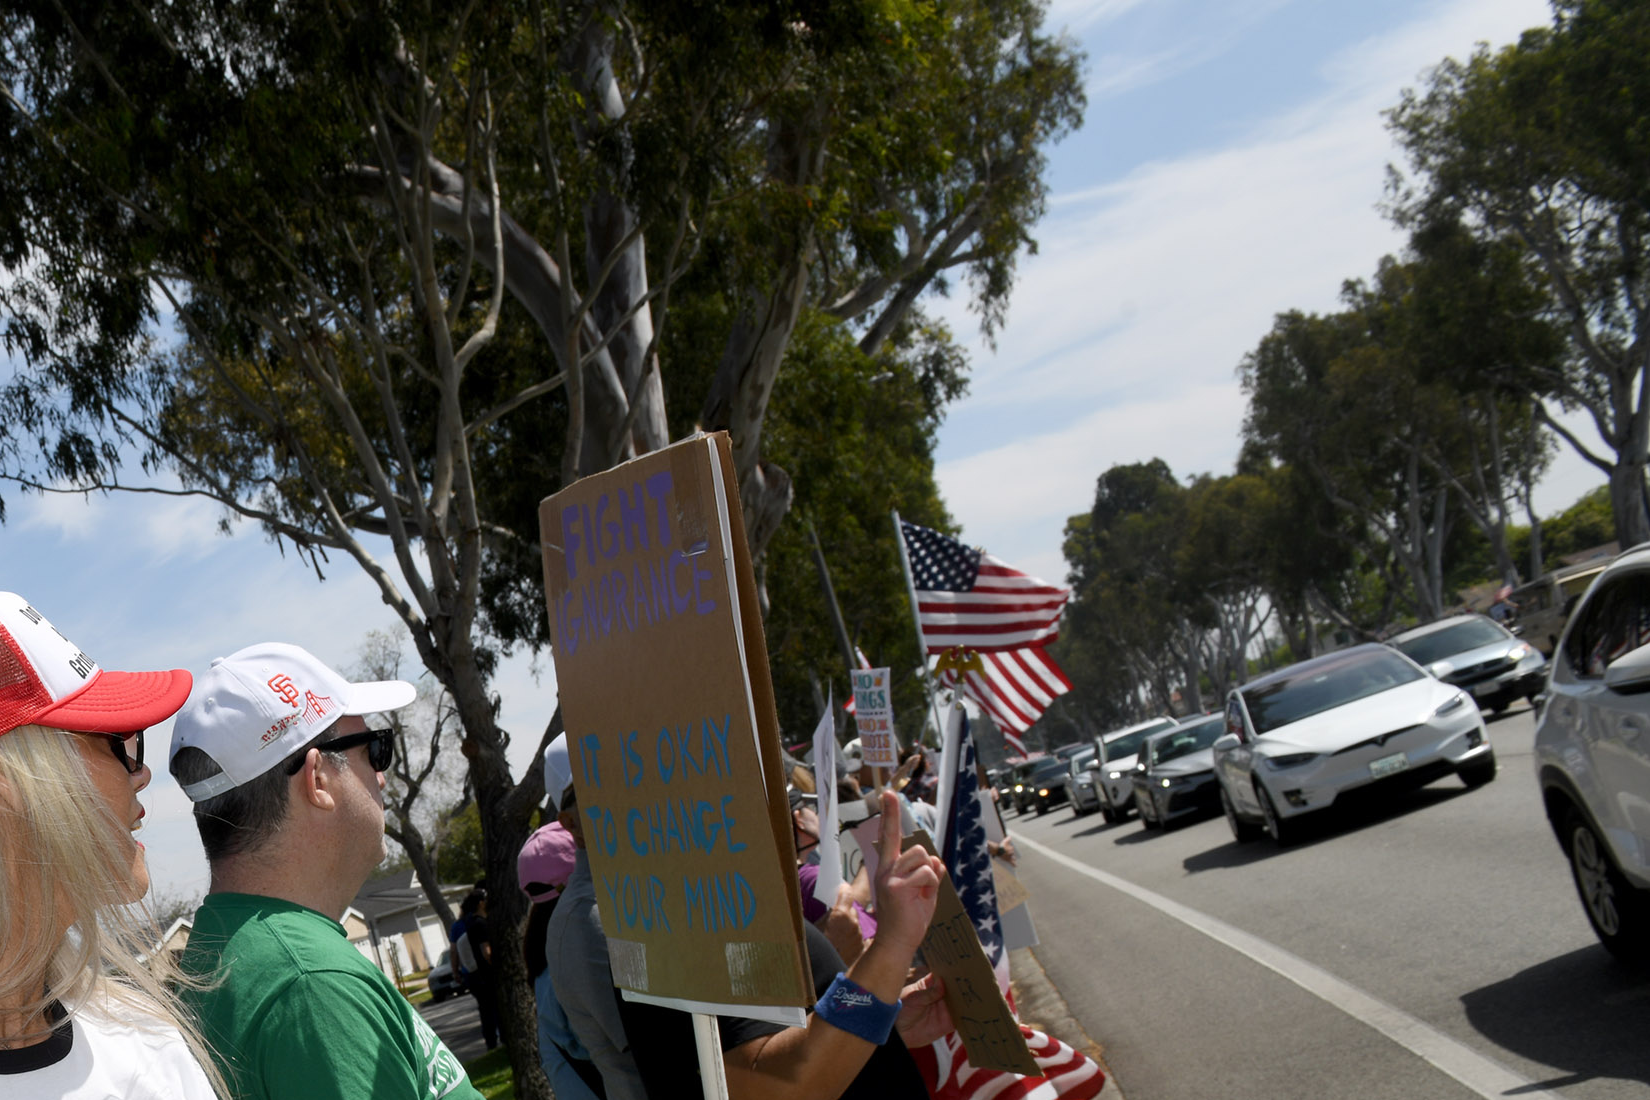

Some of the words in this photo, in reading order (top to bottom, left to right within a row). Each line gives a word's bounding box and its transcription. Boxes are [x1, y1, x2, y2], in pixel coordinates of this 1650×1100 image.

[561, 471, 673, 581] FIGHT
[555, 545, 717, 657] IGNORANCE
[578, 733, 602, 789] IT
[618, 730, 644, 788] IS
[657, 713, 732, 785] OKAY
[585, 805, 618, 857] TO
[626, 795, 748, 857] CHANGE
[602, 871, 672, 934] YOUR
[683, 870, 757, 934] MIND
